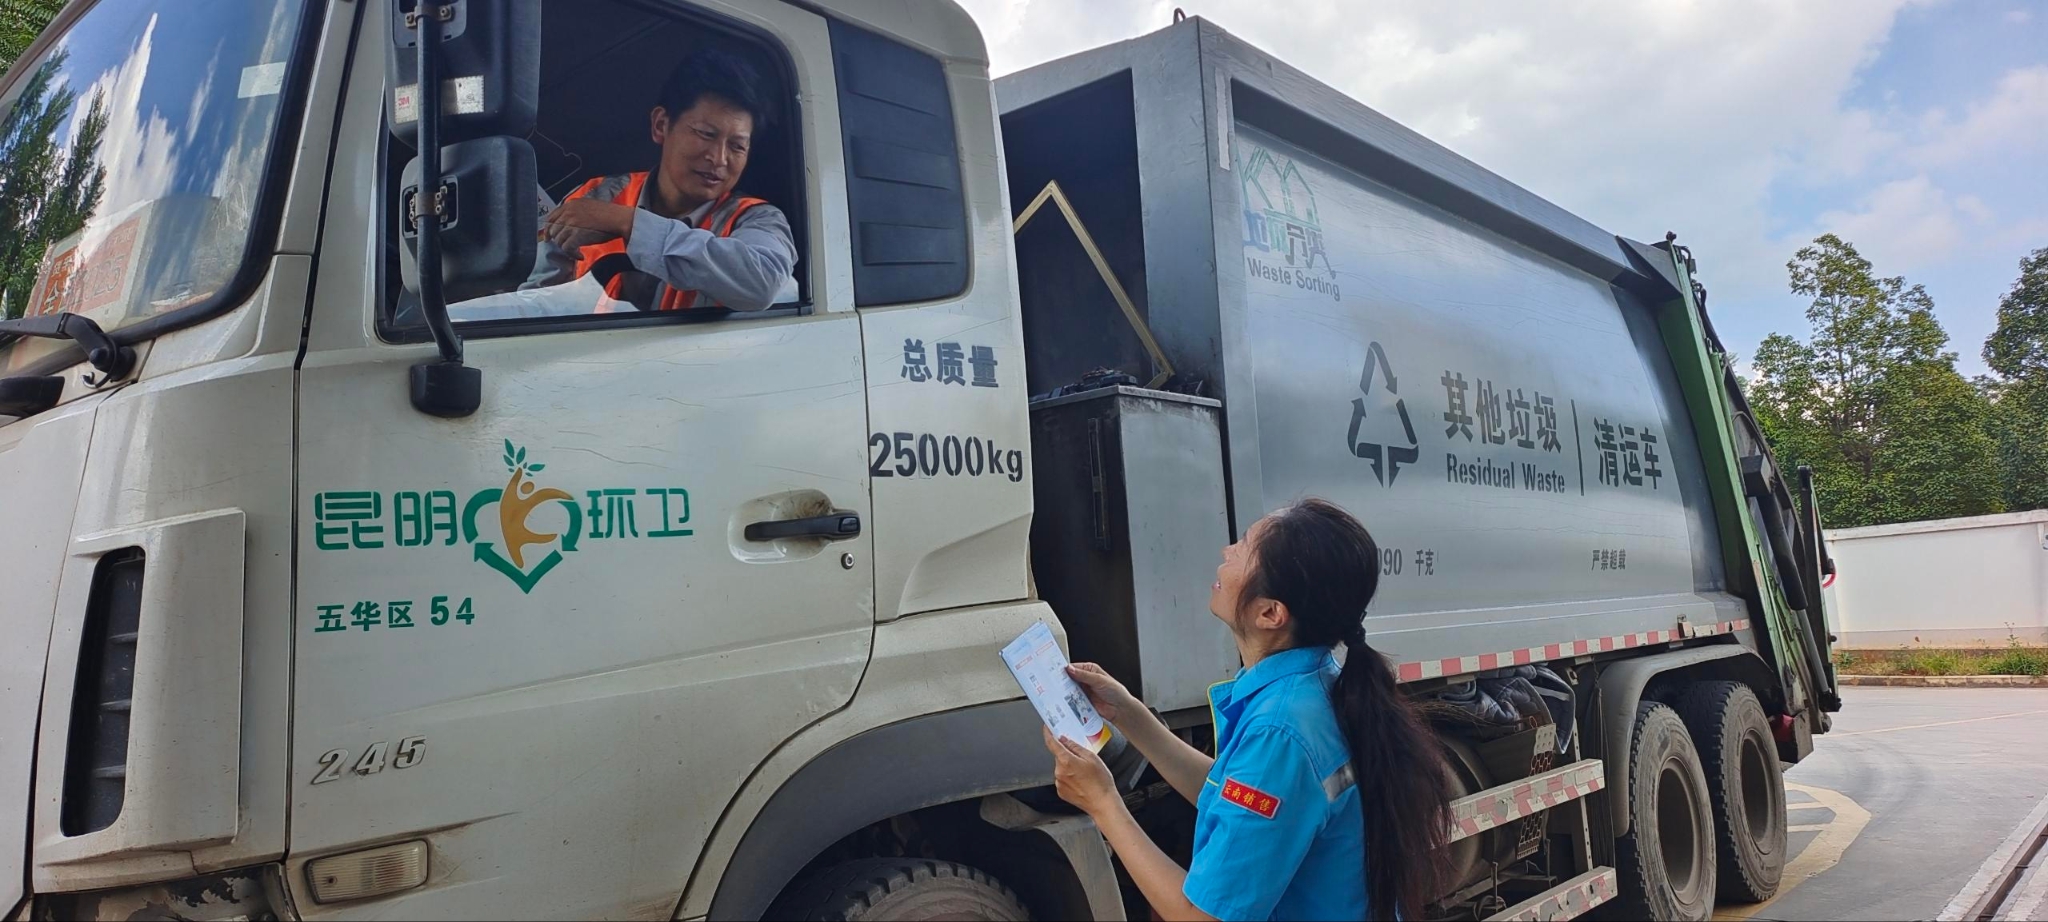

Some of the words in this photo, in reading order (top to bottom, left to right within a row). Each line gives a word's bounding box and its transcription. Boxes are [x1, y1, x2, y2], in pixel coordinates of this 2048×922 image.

[1247, 257, 1292, 285] Waste
[1295, 269, 1341, 301] Sorting
[901, 338, 999, 388] 总质量
[1441, 370, 1562, 454] 其他垃圾
[869, 432, 1023, 482] 25000kg
[1446, 453, 1515, 490] Residual
[1522, 462, 1565, 494] Waste
[1593, 416, 1663, 490] 清运车
[314, 490, 458, 551] 昆明
[586, 487, 694, 539] 环卫
[1415, 548, 1434, 576] 千克
[1591, 549, 1626, 571] 严禁超载
[314, 601, 415, 633] 五华区
[430, 596, 475, 626] 54
[310, 735, 428, 785] 245
